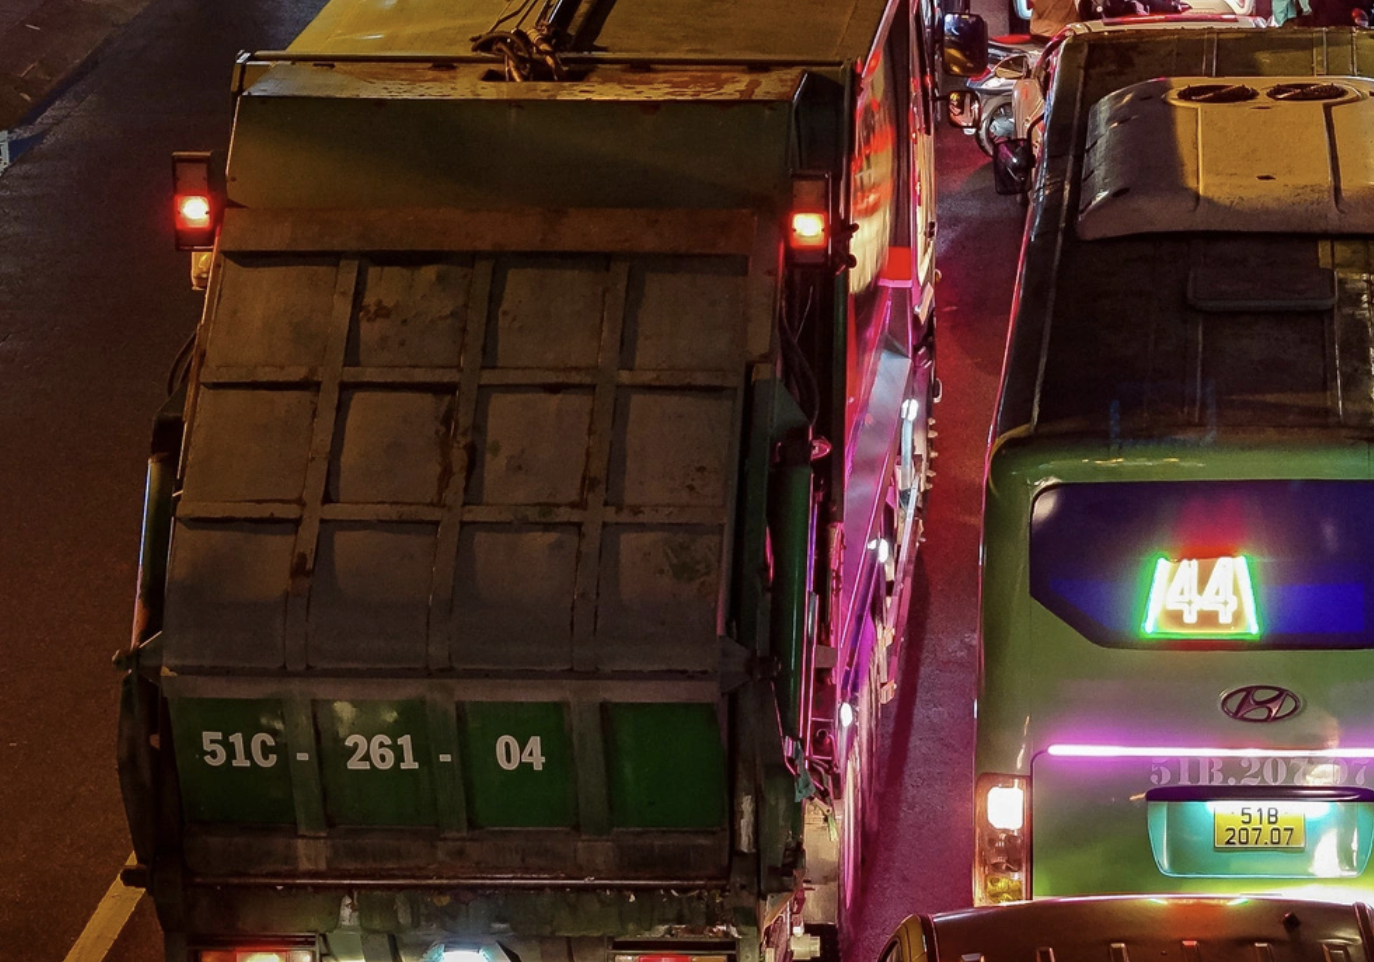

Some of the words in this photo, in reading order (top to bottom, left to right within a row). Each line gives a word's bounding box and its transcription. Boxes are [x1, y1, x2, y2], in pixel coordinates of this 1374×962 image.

[1166, 556, 1238, 625] 44
[202, 731, 277, 768] 51C
[344, 734, 419, 770] 261
[495, 735, 546, 771] 04
[1241, 806, 1279, 825] 51B
[1224, 827, 1295, 846] 207.07
